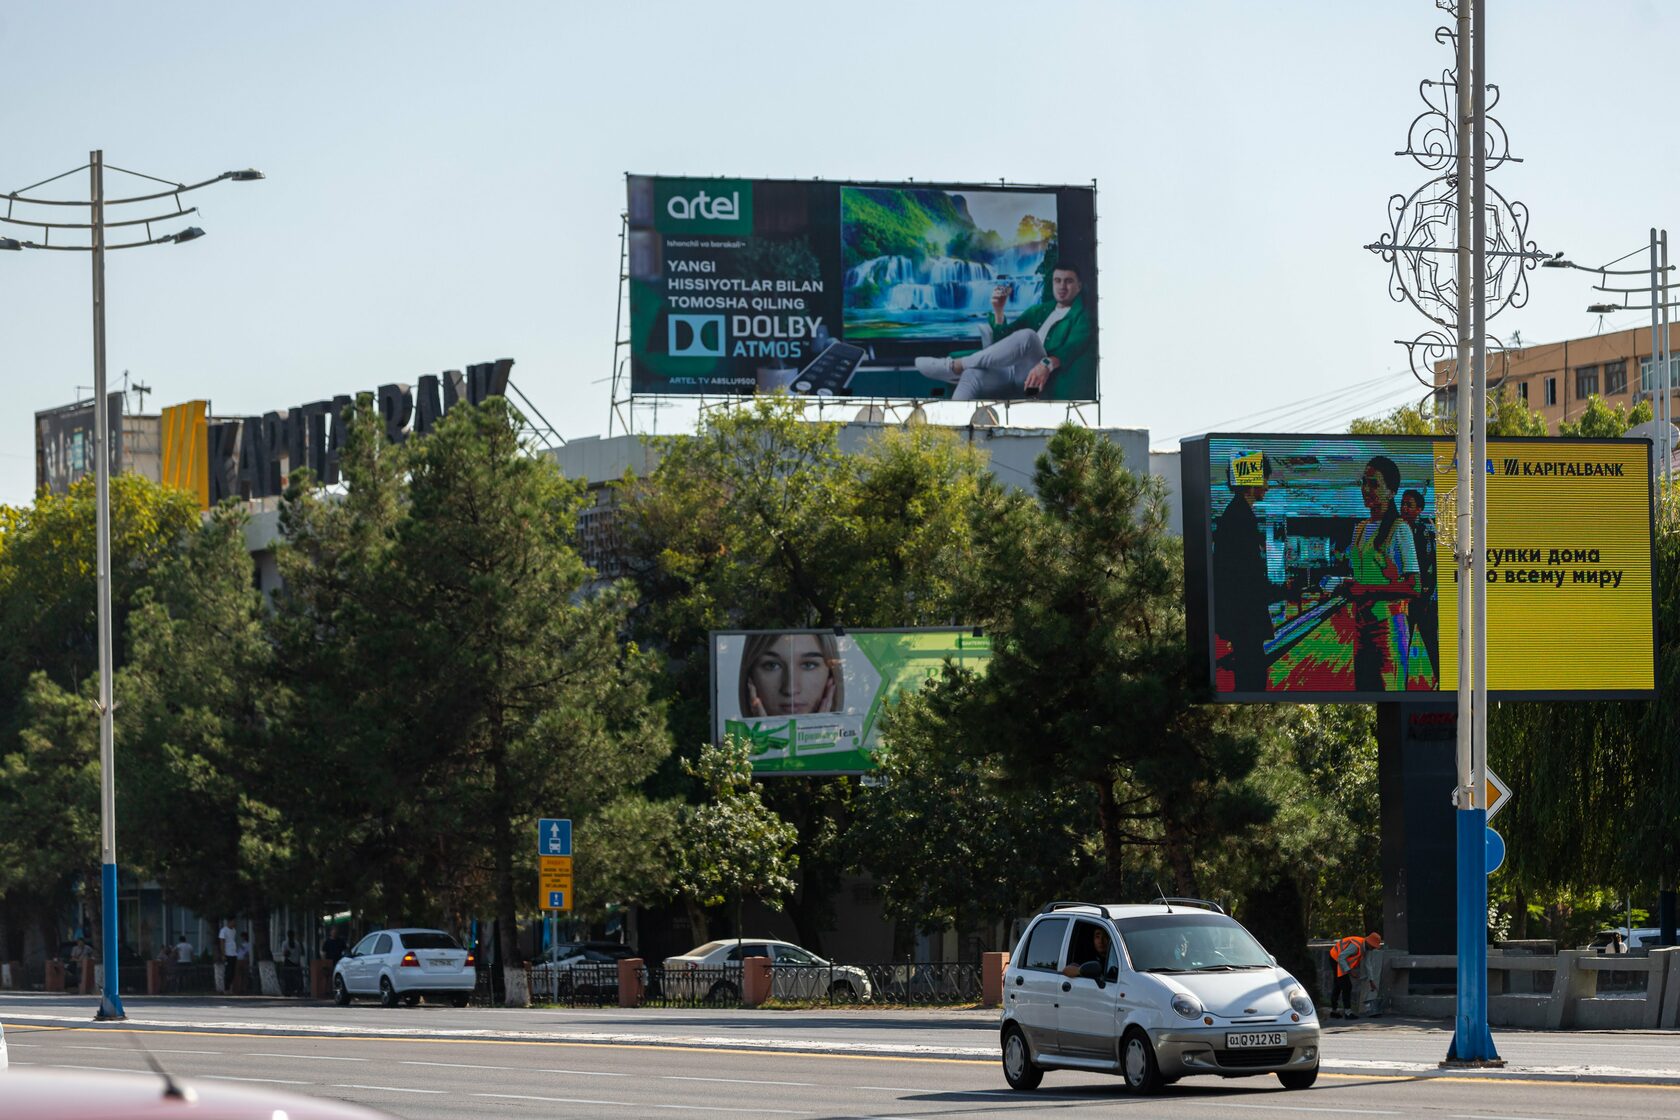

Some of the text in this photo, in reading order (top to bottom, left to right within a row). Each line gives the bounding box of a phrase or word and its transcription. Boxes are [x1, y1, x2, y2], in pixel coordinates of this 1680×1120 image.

[667, 191, 739, 220] artel
[667, 260, 716, 272] YANGI
[668, 278, 823, 292] HISSIYOTLAR BILAN
[668, 296, 805, 311] TOMOSHA QILING
[732, 315, 823, 337] DOLBY
[1523, 462, 1624, 477] KAPITALBANK
[1548, 549, 1600, 565] дома
[1505, 570, 1566, 588] всему
[1573, 570, 1623, 588] миру
[1229, 1036, 1240, 1045] 01
